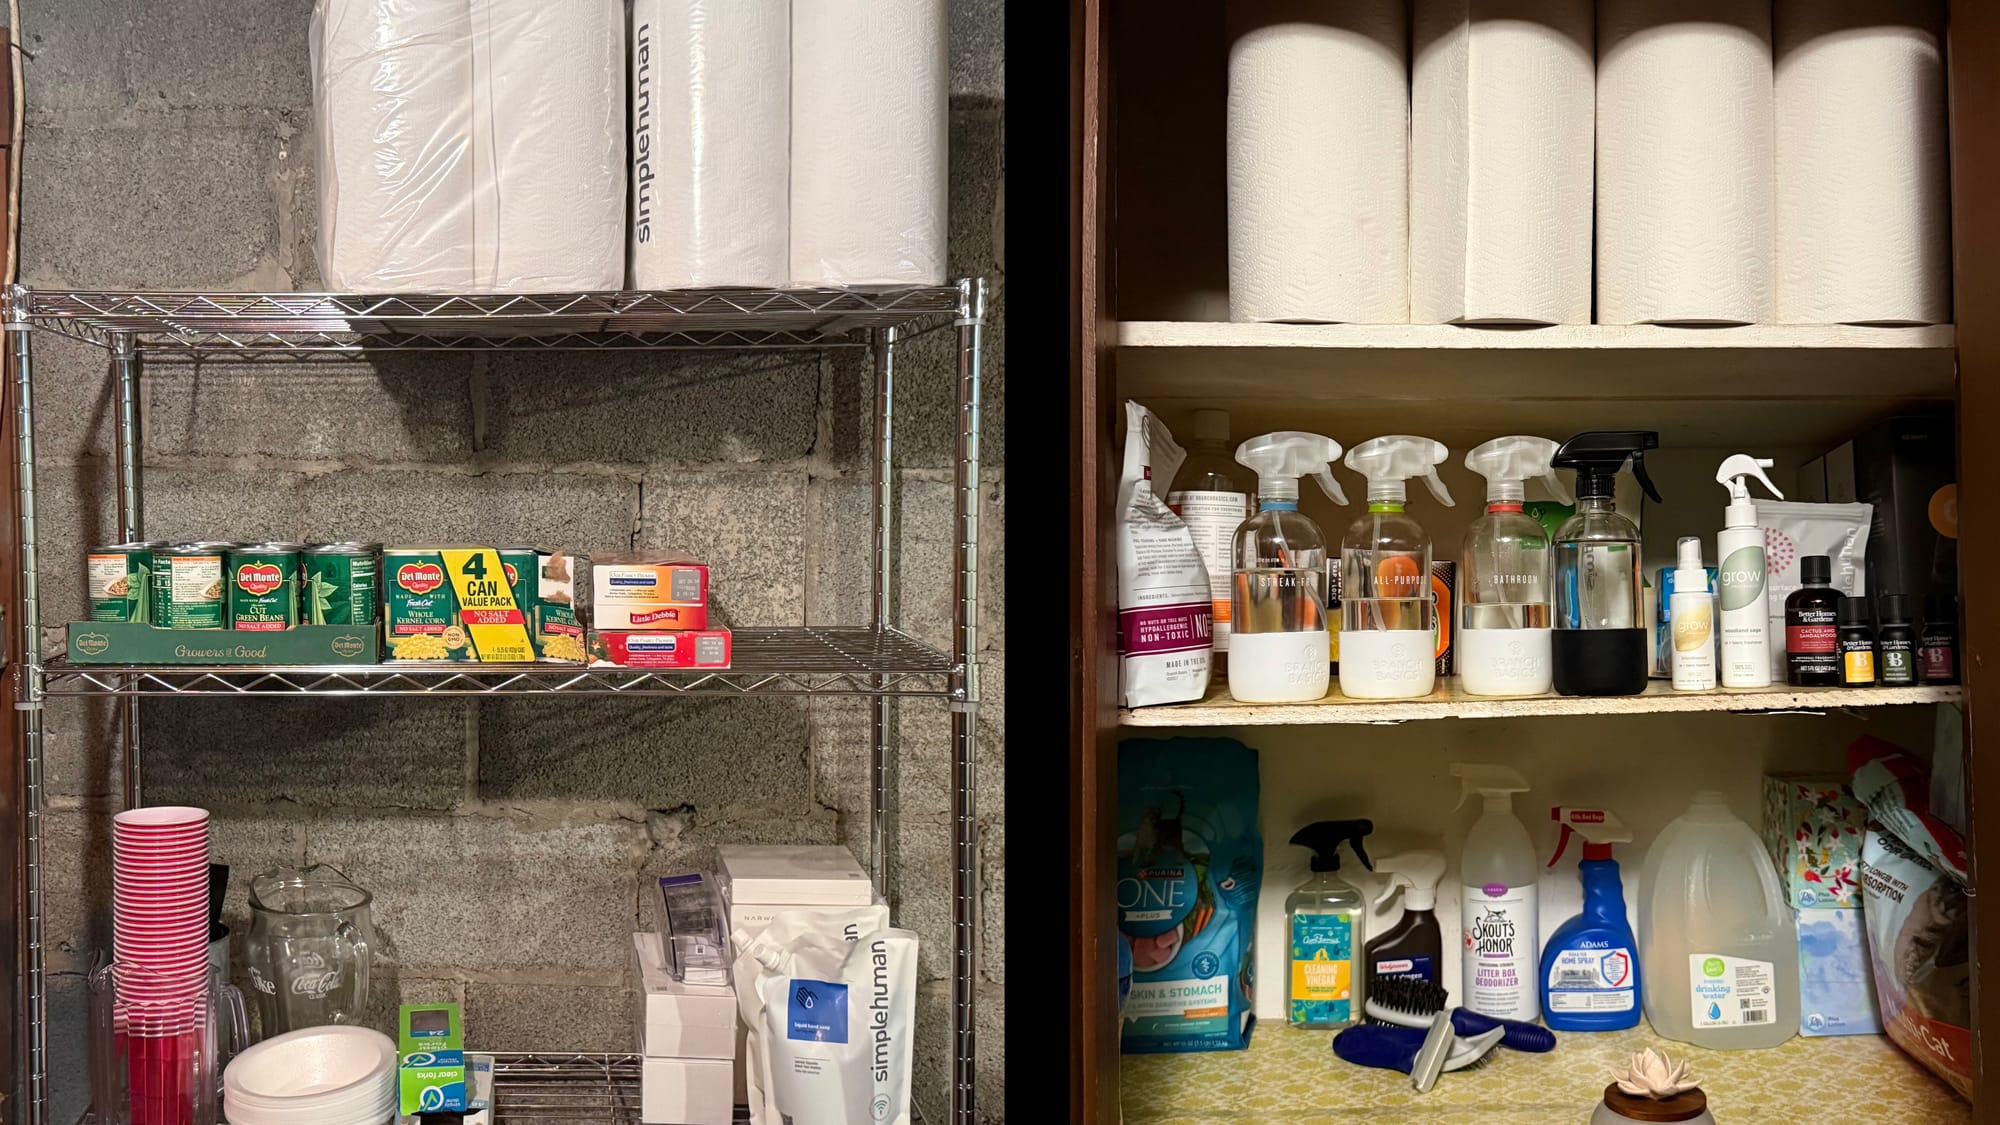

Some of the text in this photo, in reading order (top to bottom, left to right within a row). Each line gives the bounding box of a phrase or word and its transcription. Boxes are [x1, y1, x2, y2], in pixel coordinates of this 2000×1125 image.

[636, 23, 655, 244] simplehuman
[462, 553, 487, 580] 4
[240, 572, 280, 581] Del Monte
[401, 572, 440, 580] Del Monte
[1494, 575, 1537, 584] BATHROOM
[1722, 569, 1761, 586] grow
[467, 581, 497, 596] CAN
[462, 597, 512, 606] VALUE PACK
[249, 606, 267, 614] CUT
[632, 610, 676, 623] Little Debbie
[236, 613, 284, 621] GREEN BEANS
[397, 616, 424, 624] KERNEL
[1140, 622, 1188, 633] HYPOALLERGENIC
[1194, 614, 1208, 638] NO
[1679, 620, 1708, 633] grow
[1141, 630, 1190, 643] NON-TOXIC
[175, 644, 267, 658] Growers Good
[1166, 660, 1181, 668] MADE
[1870, 866, 1910, 891] LONGER WITH
[1117, 877, 1185, 908] ONE
[1864, 873, 1905, 905] BSORPTION
[1472, 917, 1515, 940] SKOUT'S
[1475, 938, 1514, 957] HONOR
[1304, 963, 1338, 974] CLEANING
[1477, 968, 1516, 977] LITTER BOX
[247, 966, 277, 995] Coke
[1306, 974, 1336, 985] VINEGAR
[1475, 977, 1519, 987] DEODORIZER
[1130, 984, 1222, 999] SKIN & STOMACH
[1695, 984, 1731, 993] drinking
[870, 940, 891, 1083] simplehuman
[416, 1071, 458, 1079] clear forks
